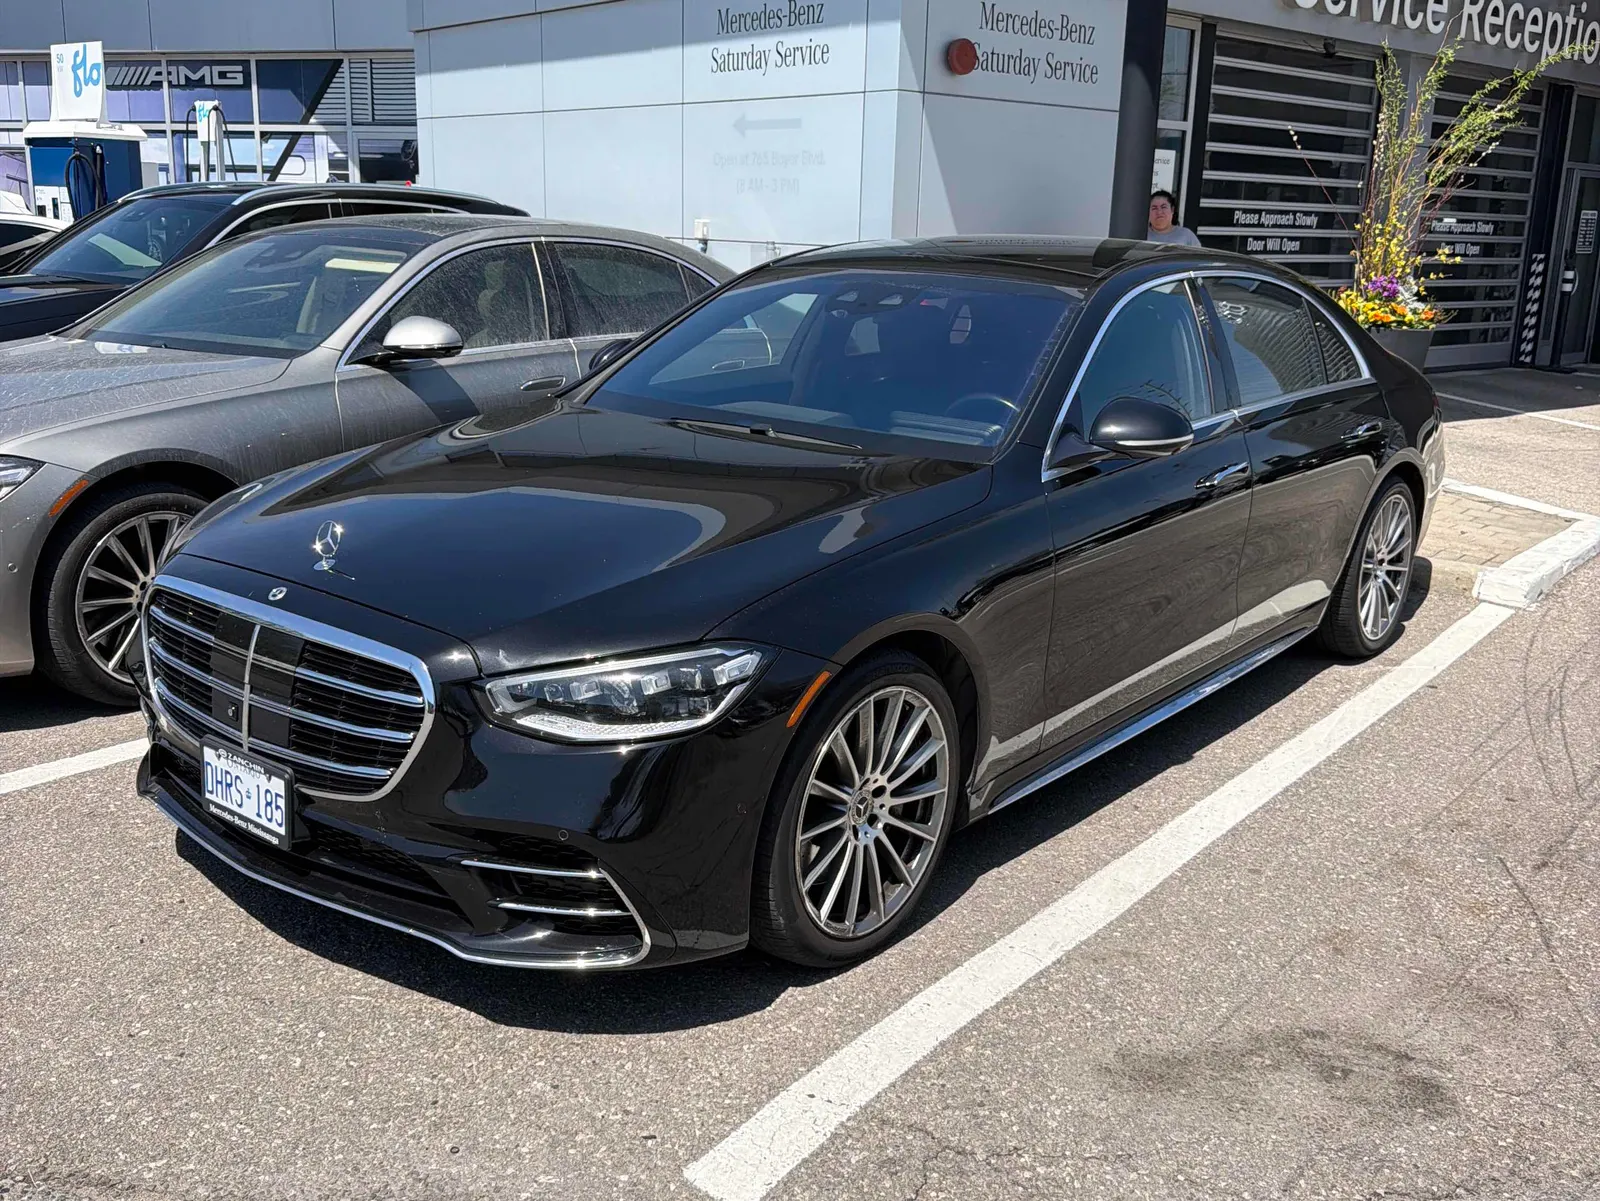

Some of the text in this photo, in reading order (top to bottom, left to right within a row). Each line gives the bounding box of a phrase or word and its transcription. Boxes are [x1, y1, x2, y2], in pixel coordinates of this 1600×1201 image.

[717, 0, 824, 35] Mercedes-Benz
[979, 1, 1096, 46] Mercedes-Benz
[1294, 0, 1600, 65] vice Receptio
[56, 53, 64, 64] 50
[711, 38, 830, 76] Saturday Service
[972, 42, 1098, 85] Saturday Service
[71, 43, 102, 98] flo
[144, 65, 244, 86] AMG
[713, 152, 738, 170] Open
[747, 178, 764, 192] AM
[770, 178, 778, 192] 3
[1233, 210, 1318, 229] Please Approach Slowly
[1431, 220, 1494, 235] Please Approach Slowly
[1247, 237, 1300, 253] Door Will Open
[1454, 243, 1466, 254] Will
[1466, 243, 1480, 256] Open
[227, 752, 265, 774] ZANCHIN
[205, 761, 284, 828] DHRS 185
[209, 803, 247, 829] Mercedes-Benz
